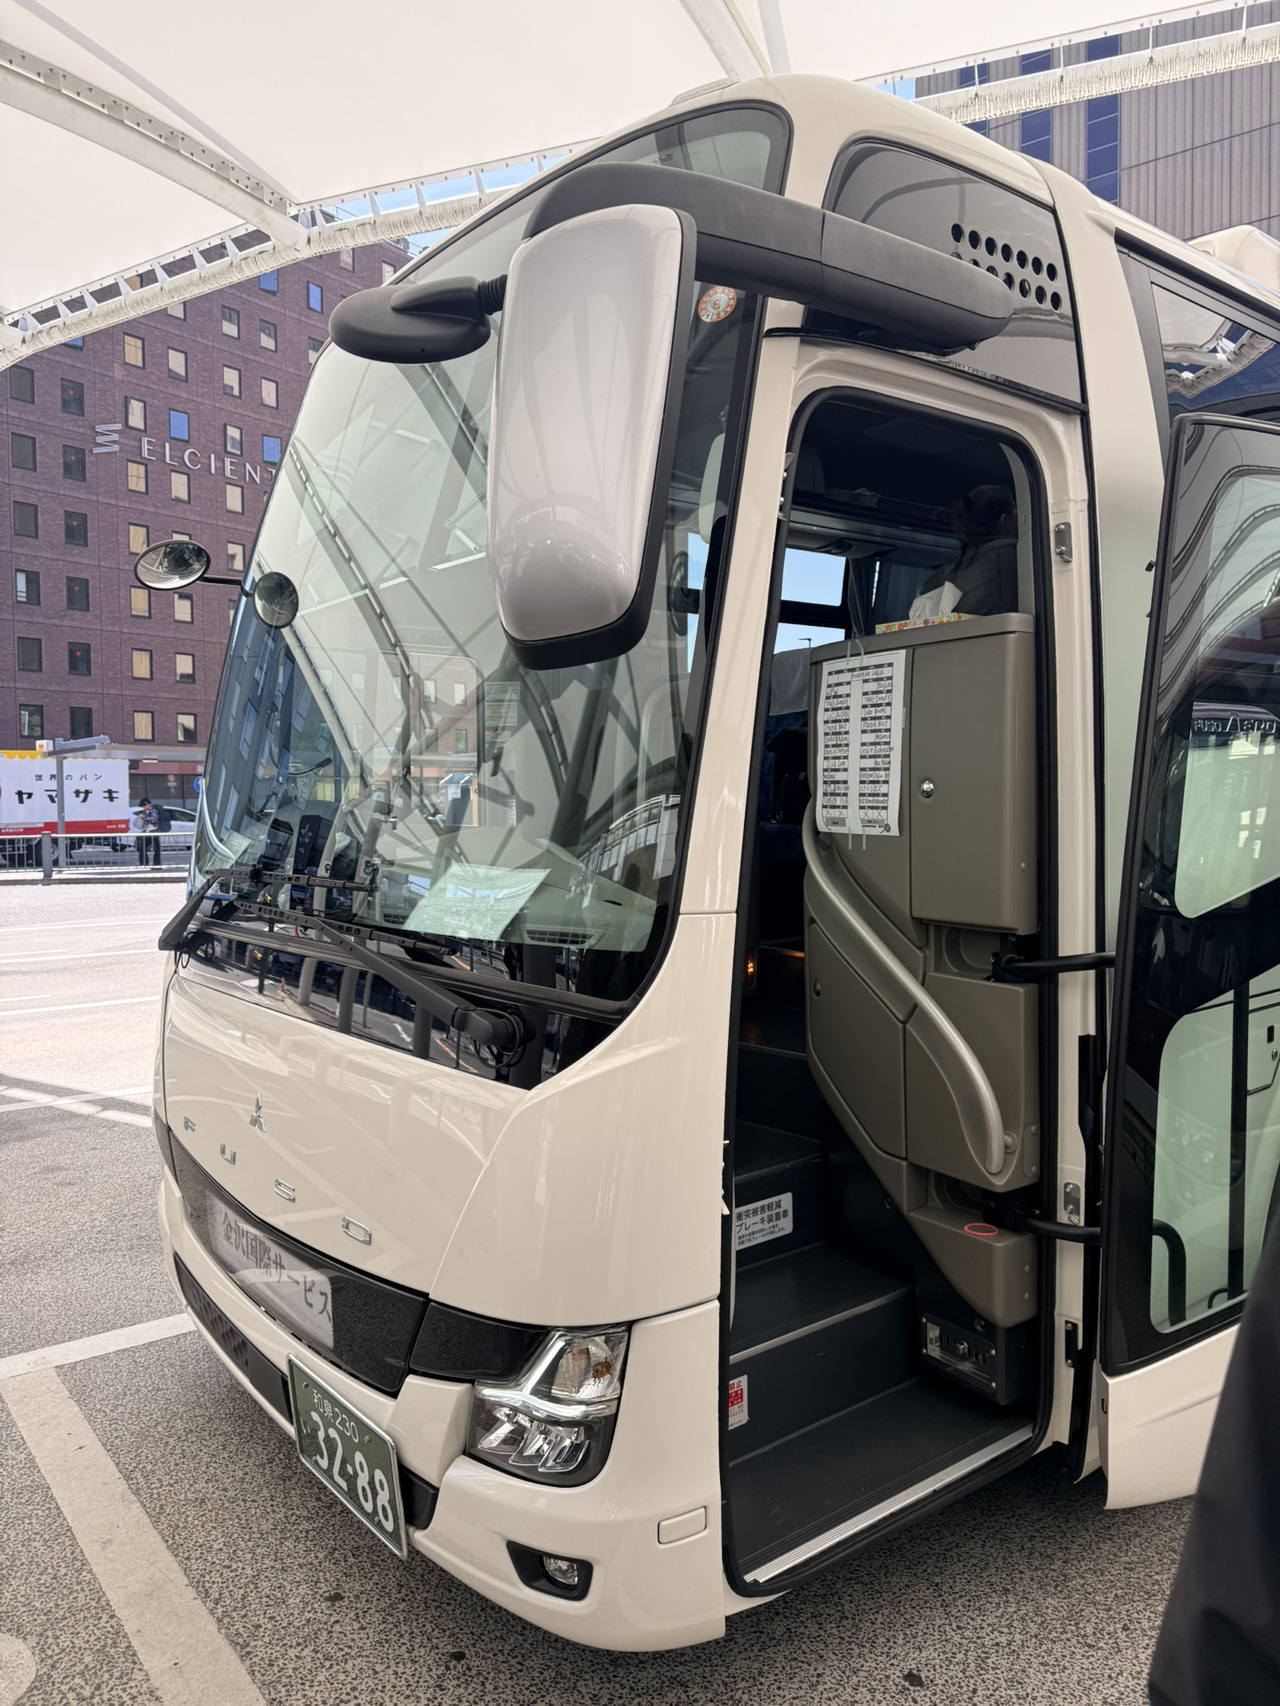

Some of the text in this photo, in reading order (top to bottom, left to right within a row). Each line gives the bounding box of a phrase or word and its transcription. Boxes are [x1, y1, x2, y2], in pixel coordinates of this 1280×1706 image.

[15, 788, 120, 805] ヤマザキ
[183, 1115, 373, 1245] FUSO
[736, 1208, 789, 1234] ブレーキ装着車
[221, 1210, 332, 1323] 金沢国際サービス
[310, 1410, 395, 1534] 32-88
